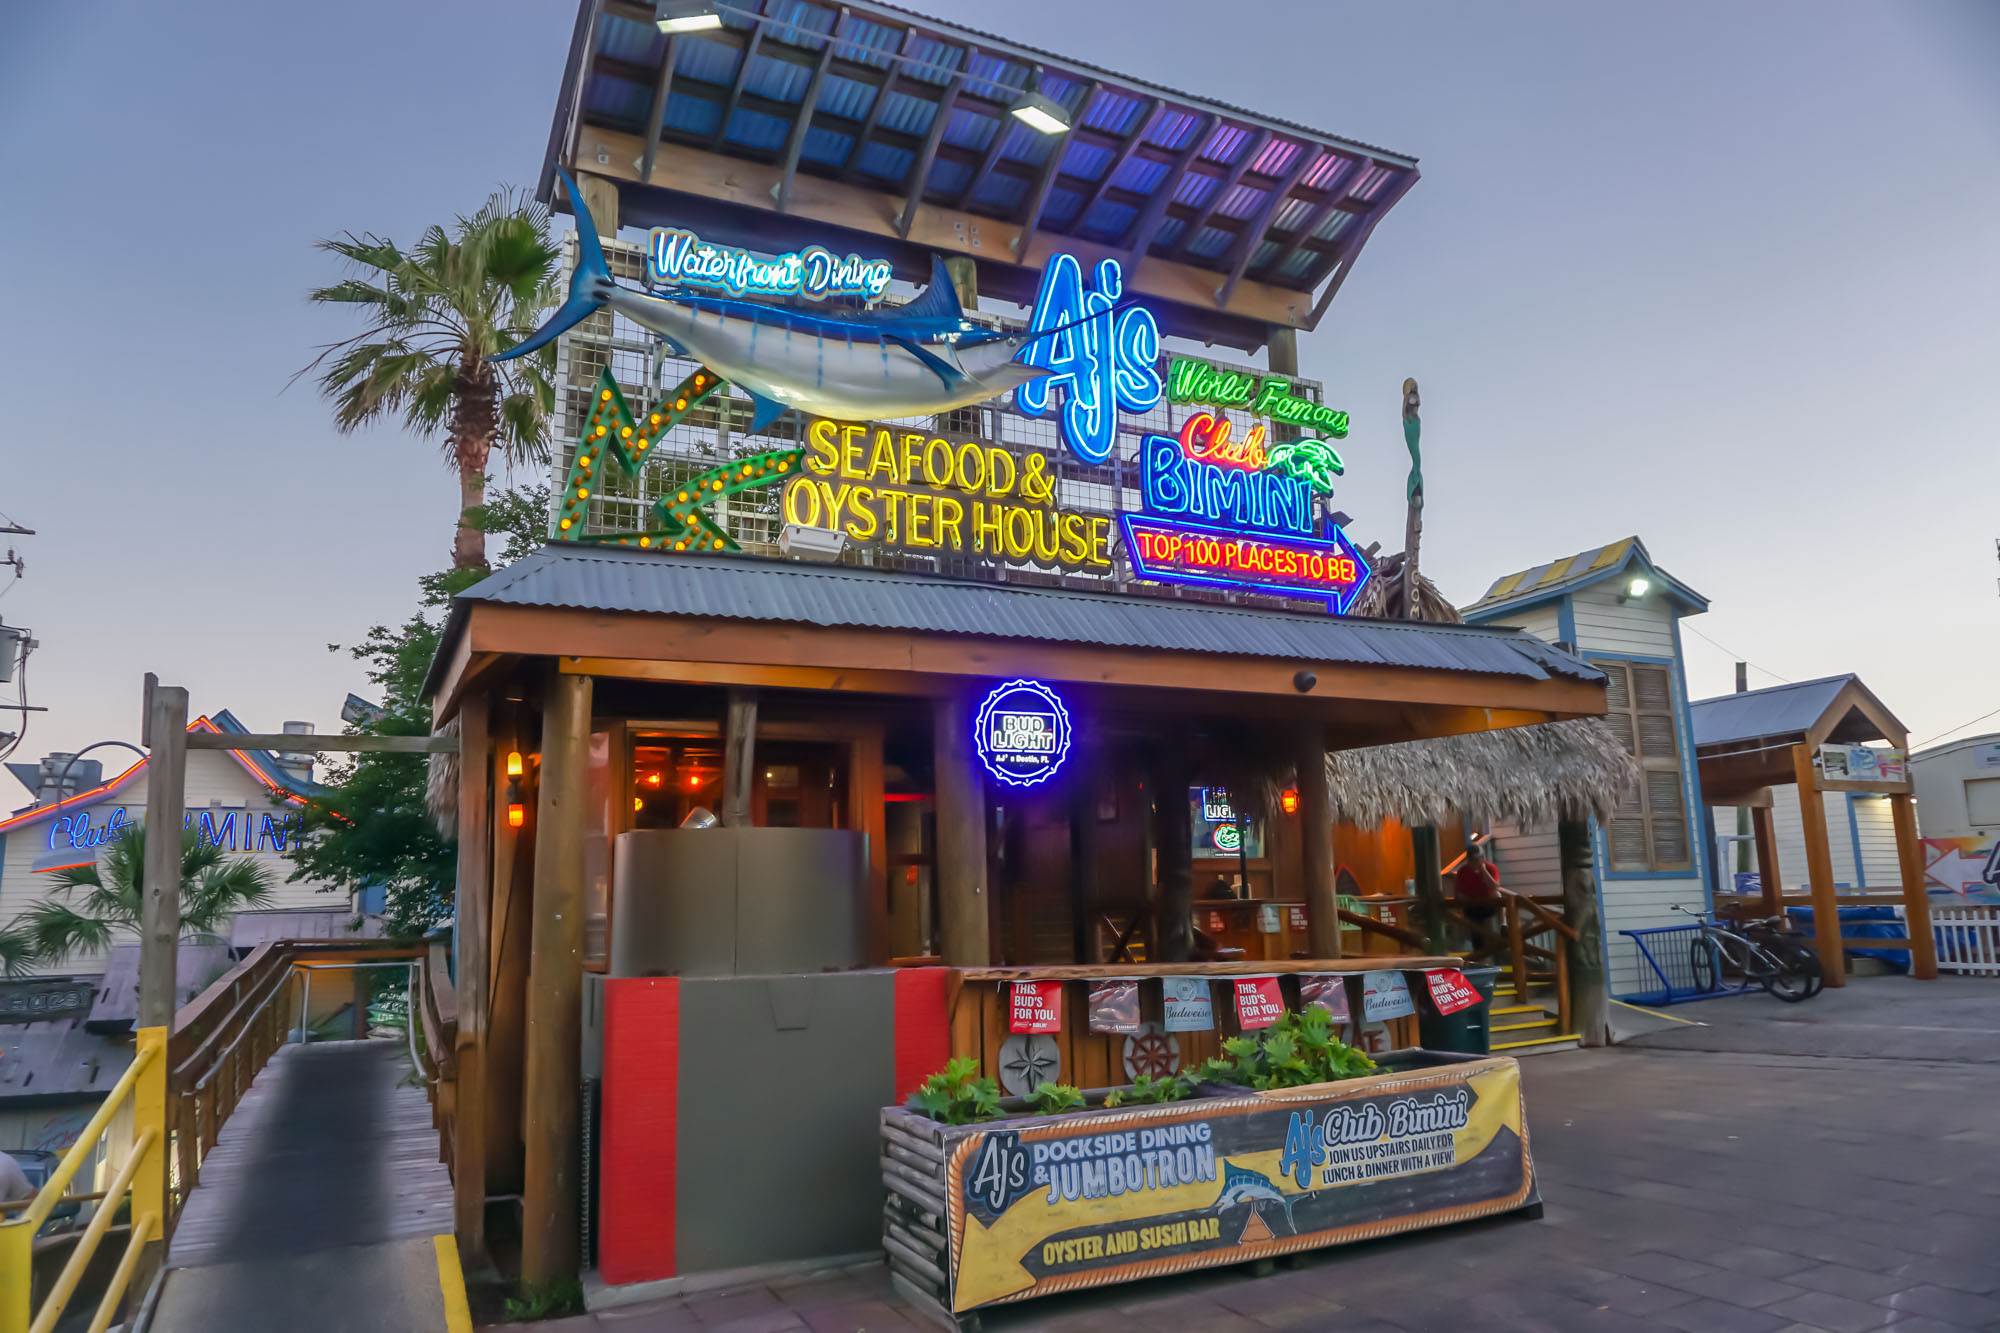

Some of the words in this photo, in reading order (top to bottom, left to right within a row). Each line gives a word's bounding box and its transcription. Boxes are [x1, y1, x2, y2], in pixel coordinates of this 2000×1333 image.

[655, 230, 802, 290] Waterfront
[806, 250, 892, 296] Dining
[1172, 359, 1249, 406] World
[1257, 380, 1349, 434] Famous
[1184, 413, 1267, 469] Club
[807, 419, 1016, 498] SEAFOOD
[1019, 452, 1056, 507] &
[1143, 434, 1313, 534] BIMINI
[784, 477, 964, 549] OYSTER
[972, 501, 1111, 567] HOUSE
[1137, 532, 1182, 560] TOP
[1183, 539, 1220, 566] 100
[1225, 543, 1297, 574] PLACES
[1296, 554, 1324, 578] TO
[1003, 715, 1045, 732] BUD
[994, 730, 1053, 750] LIGHT
[1015, 984, 1037, 995] THIS
[1238, 983, 1257, 994] THIS
[1429, 974, 1445, 985] THIS
[1431, 983, 1456, 995] BUD'S
[1014, 996, 1043, 1008] BUD'S
[1240, 994, 1267, 1006] BUD'S
[1241, 1006, 1261, 1017] FOR
[1260, 1004, 1283, 1015] YOU.
[1435, 994, 1454, 1005] FOR
[1451, 987, 1473, 1000] YOU.
[1013, 1008, 1033, 1020] FOR
[1034, 1008, 1057, 1021] YOU.
[1323, 1103, 1385, 1147] Club
[1388, 1090, 1468, 1139] Bimini
[1140, 1122, 1212, 1150] DINING
[1329, 1150, 1350, 1165] JOIN
[1350, 1149, 1365, 1161] US
[1365, 1141, 1412, 1159] UPSTAIRS
[1412, 1136, 1436, 1154] DAILY
[1436, 1133, 1454, 1148] FOR
[1033, 1164, 1050, 1185] &
[1047, 1143, 1217, 1205] JUMBOTRON
[1321, 1166, 1356, 1185] LUNCH
[1356, 1166, 1364, 1179] &
[1365, 1160, 1400, 1178] DINNER
[1400, 1156, 1424, 1172] WITH
[1424, 1155, 1431, 1166] A
[1431, 1149, 1456, 1165] VIEW!
[1042, 1236, 1105, 1267] OYSTER
[1105, 1230, 1139, 1256] AND
[1140, 1222, 1188, 1250] SUSHI
[1190, 1218, 1221, 1242] BAR
